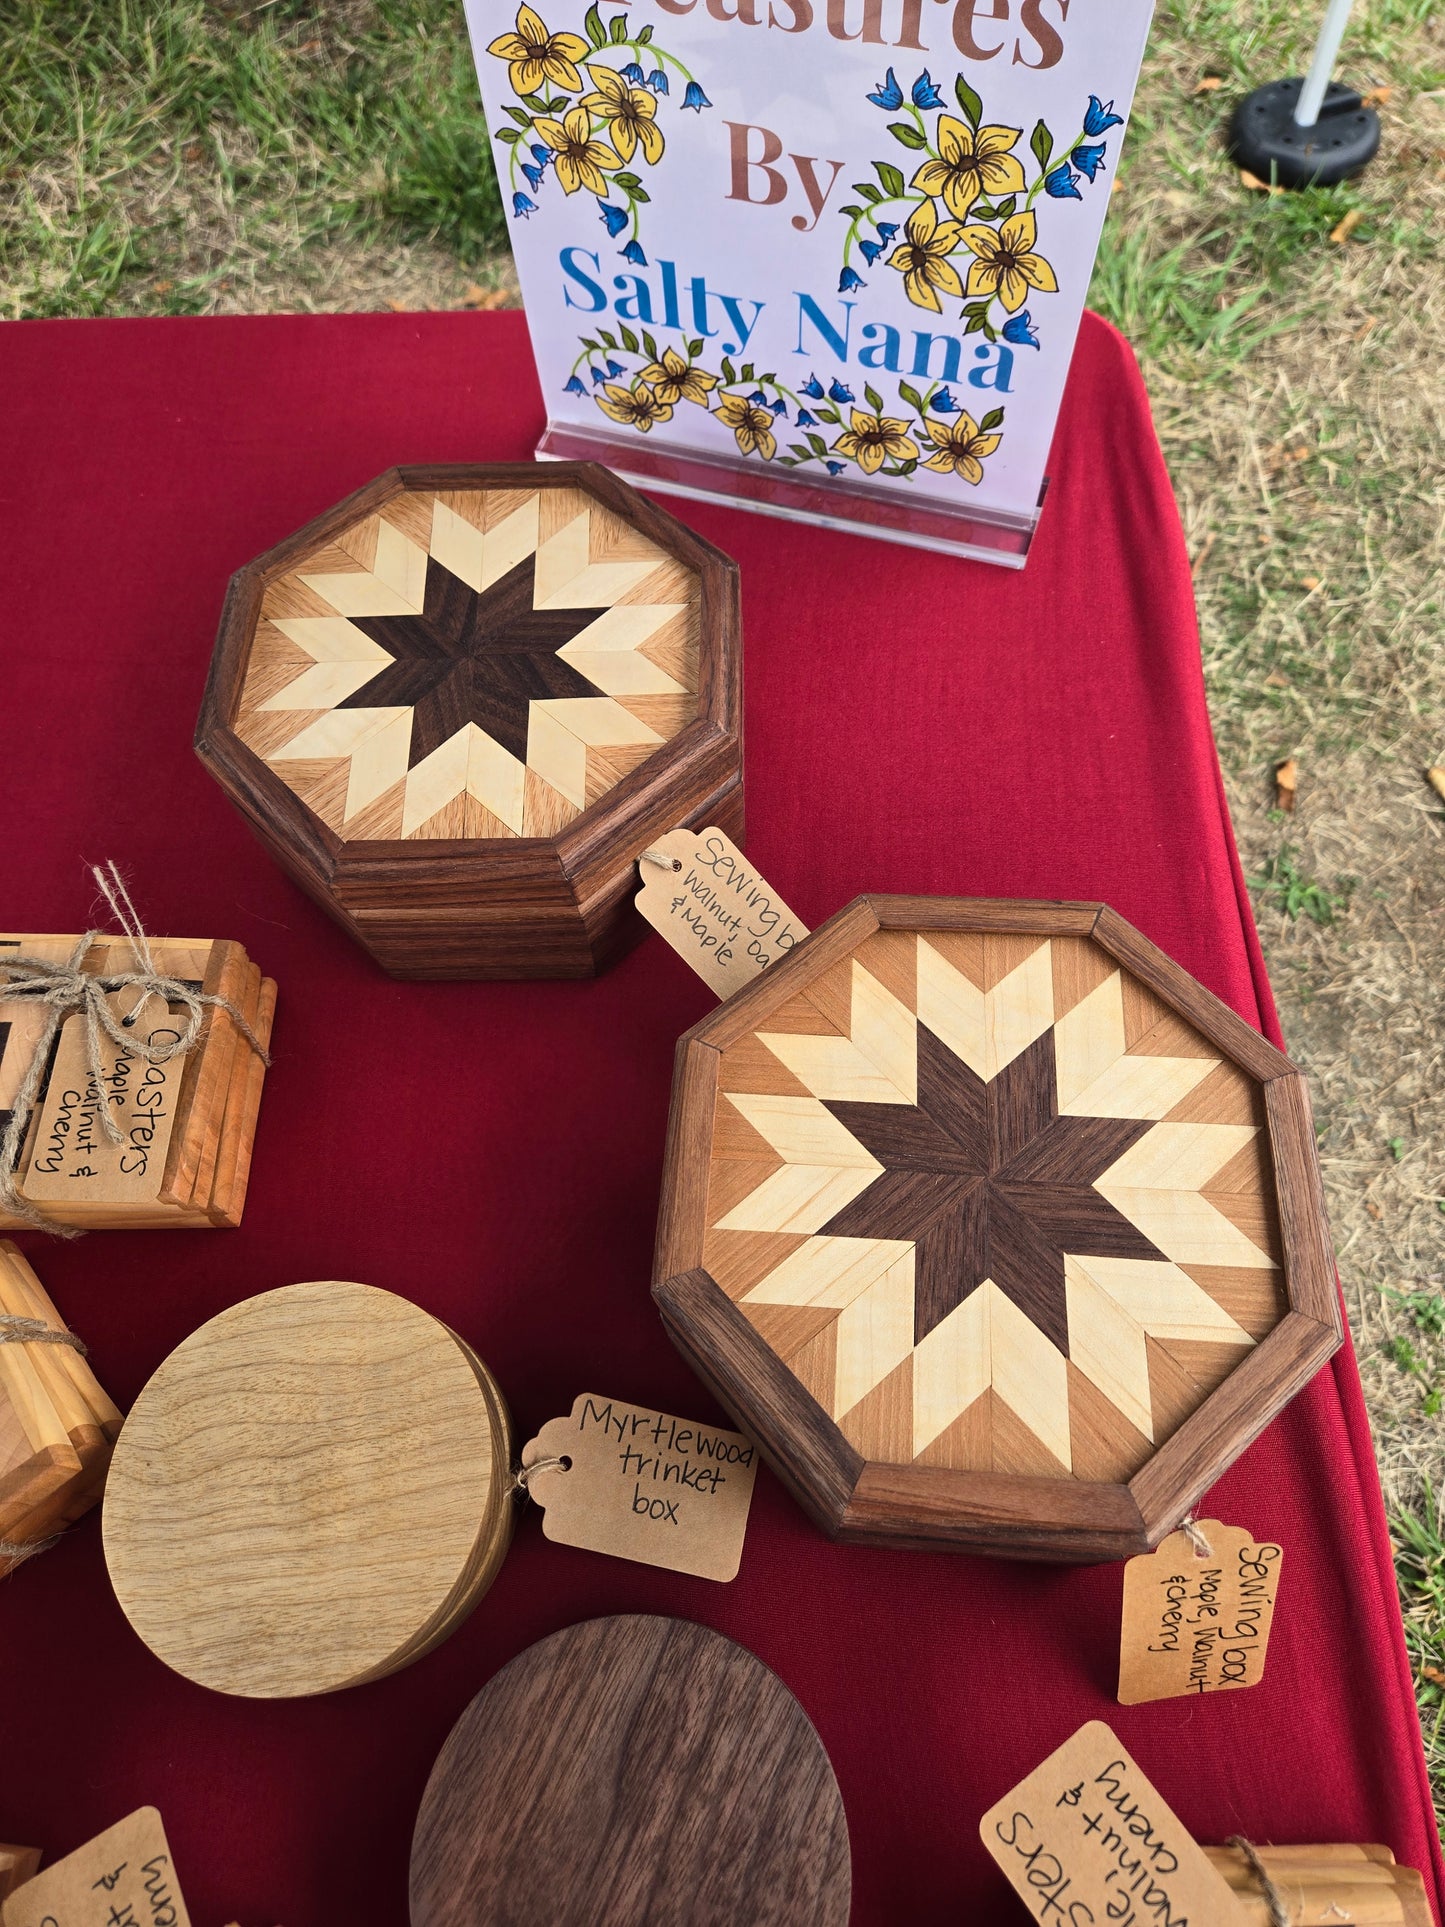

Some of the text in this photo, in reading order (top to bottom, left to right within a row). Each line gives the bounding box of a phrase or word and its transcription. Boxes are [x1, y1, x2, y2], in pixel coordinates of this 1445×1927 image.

[722, 120, 845, 231] By
[559, 246, 1016, 394] Salty Nana
[670, 895, 733, 967] & Maple
[694, 837, 780, 937] Sewing
[69, 1165, 98, 1178] &
[619, 1444, 726, 1494] trinket
[632, 1483, 680, 1525] box
[1218, 1546, 1280, 1686] Sewing box
[996, 1811, 1094, 1927] sters
